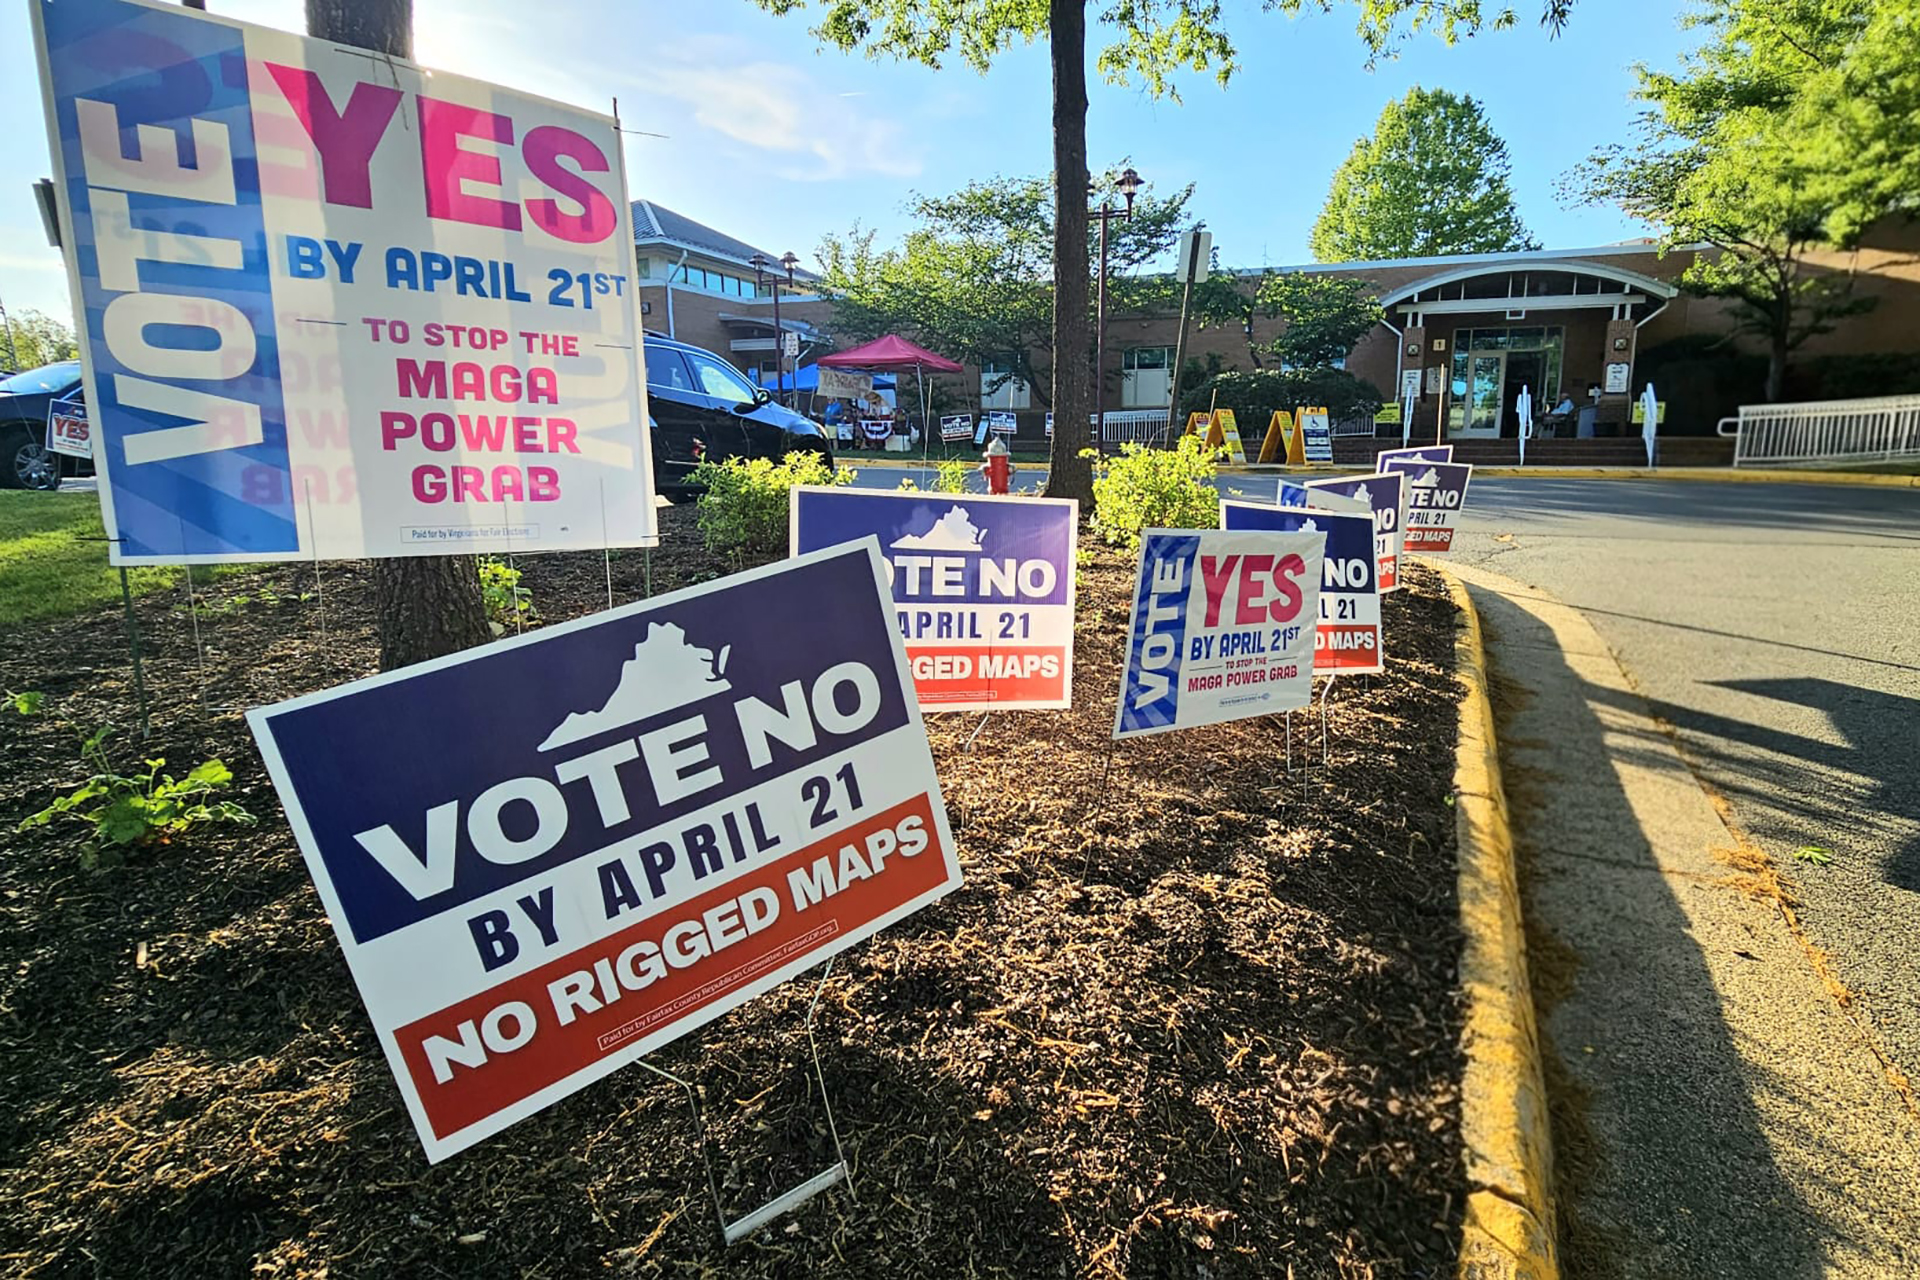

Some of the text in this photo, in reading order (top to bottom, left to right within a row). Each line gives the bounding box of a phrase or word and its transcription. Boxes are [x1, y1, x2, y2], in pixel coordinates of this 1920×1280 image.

[263, 61, 617, 243] YES
[75, 97, 264, 466] VOTE
[286, 234, 363, 284] BY
[385, 247, 531, 302] APRIL
[362, 318, 580, 357] TO STOP THE
[396, 358, 558, 404] MAGA
[53, 415, 90, 442] YES
[380, 411, 581, 453] POWER
[411, 464, 561, 503] GRAB
[1410, 488, 1459, 508] TE NO
[412, 530, 427, 539] Paid
[1408, 512, 1446, 525] PRIL 21
[1423, 531, 1451, 542] MAPS
[882, 556, 1057, 597] TE NO
[1200, 553, 1306, 628] YES
[1324, 557, 1368, 588] NO
[999, 612, 1030, 639] 21
[1338, 599, 1356, 619] 21
[1135, 557, 1185, 709] VOTE
[1190, 635, 1215, 660] BY
[1220, 631, 1266, 658] APRIL
[1329, 631, 1375, 650] MAPS
[909, 655, 1059, 680] GED MAPS
[1188, 665, 1298, 692] MAGA POWER GRAB
[1225, 657, 1268, 669] TO STOP THE
[353, 662, 881, 900] VOTE NO
[467, 762, 864, 973] BY APRIL 21
[421, 814, 929, 1085] NO RIGGED MAPS
[602, 1030, 621, 1045] Paid
[622, 1024, 634, 1036] for
[635, 1019, 646, 1030] by
[646, 1006, 673, 1023] Fairfax
[673, 993, 701, 1010] County
[701, 971, 743, 997] Republican
